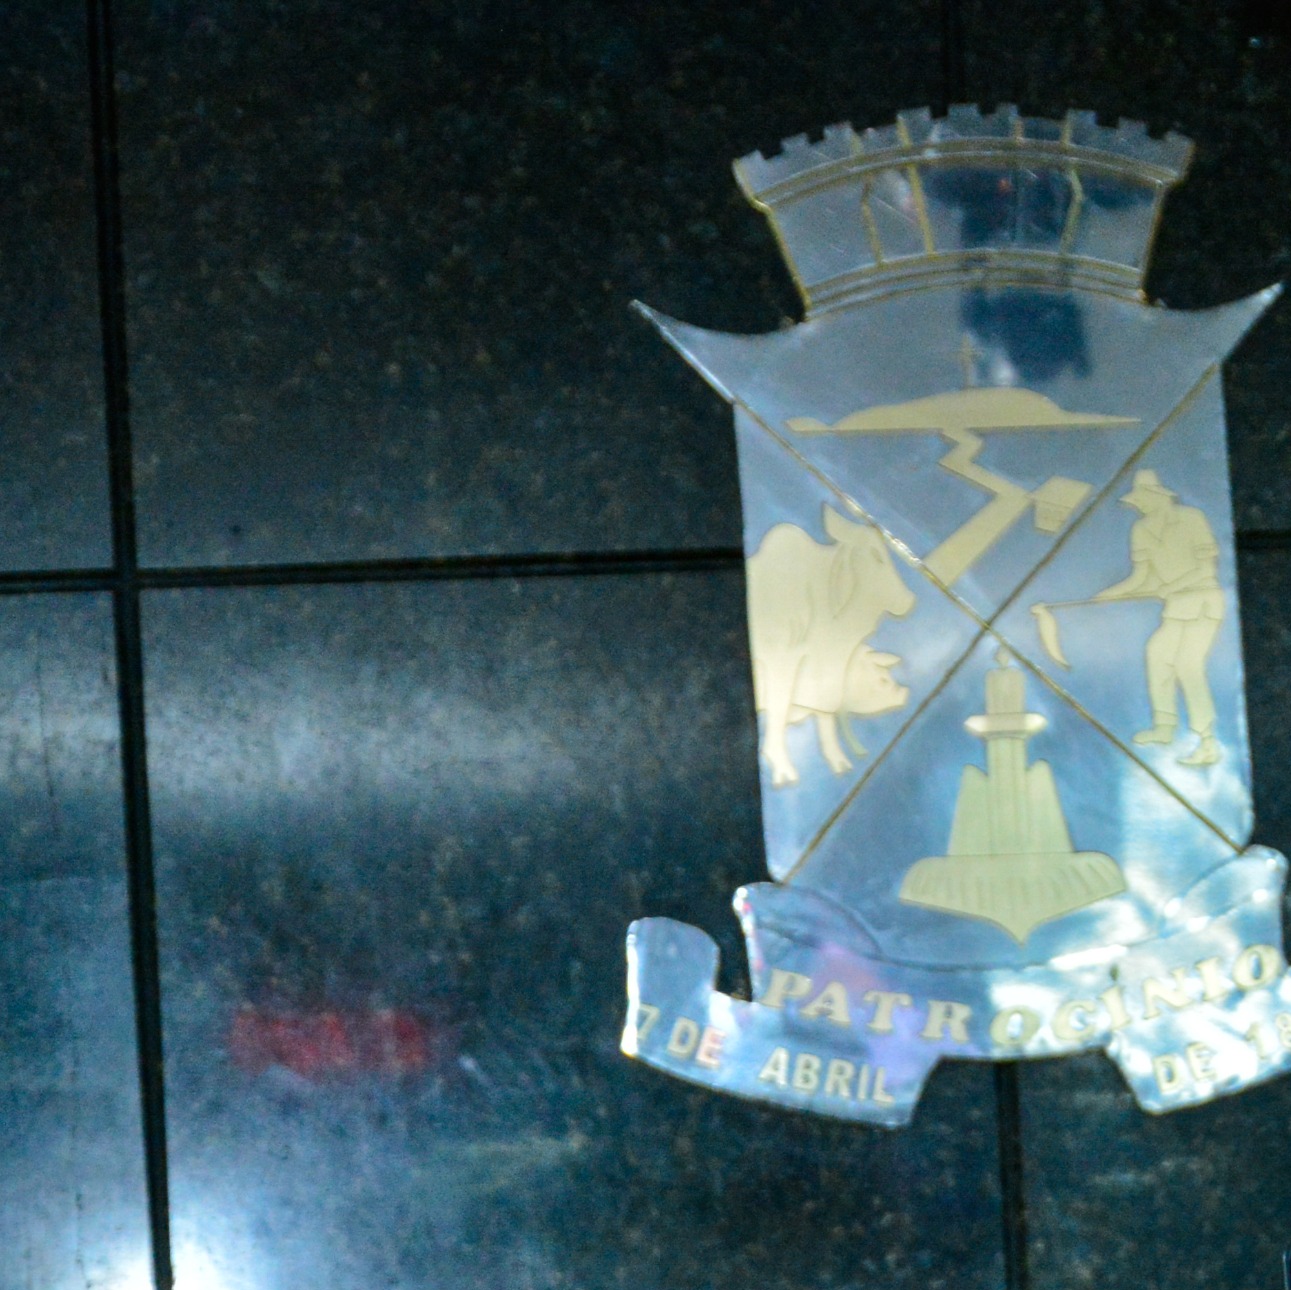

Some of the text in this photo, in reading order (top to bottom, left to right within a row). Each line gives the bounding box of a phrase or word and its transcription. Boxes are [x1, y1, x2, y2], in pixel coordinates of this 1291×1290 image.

[667, 1016, 727, 1069] DE
[758, 1046, 895, 1107] ABRIL
[1154, 1041, 1218, 1095] DE
